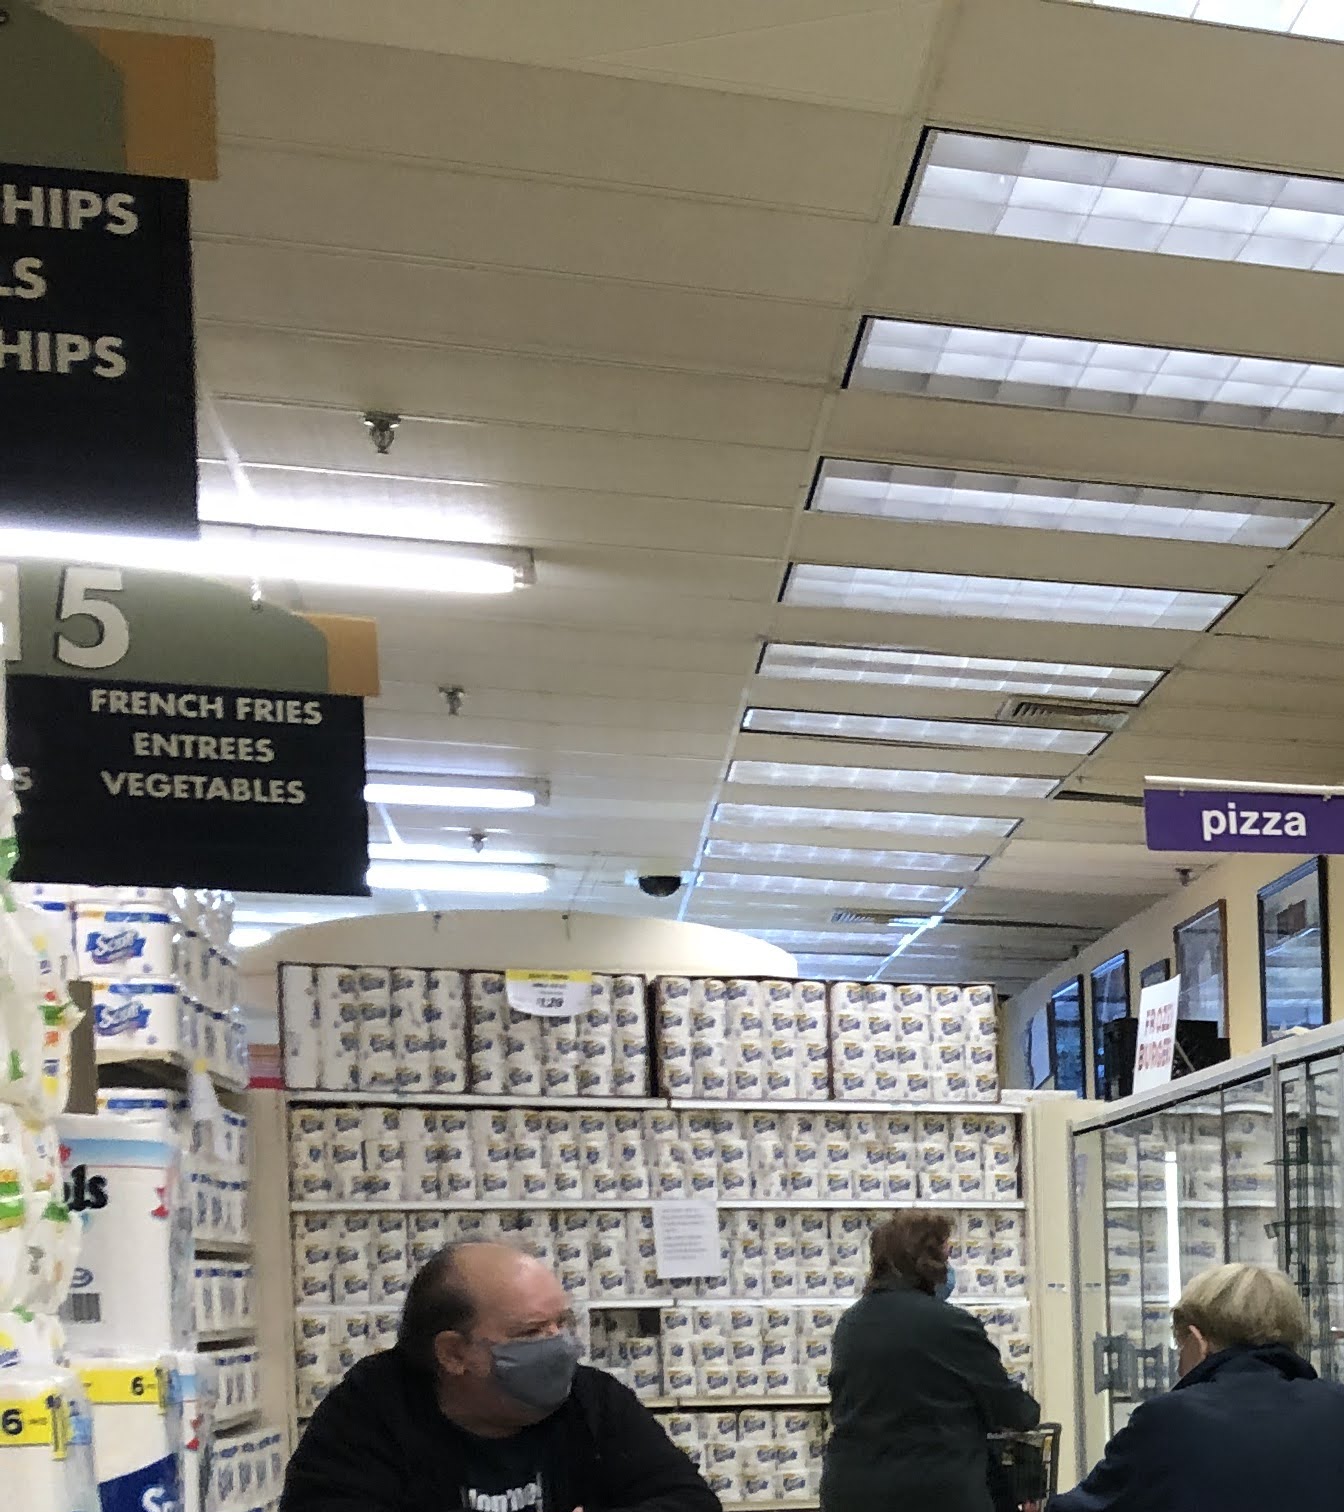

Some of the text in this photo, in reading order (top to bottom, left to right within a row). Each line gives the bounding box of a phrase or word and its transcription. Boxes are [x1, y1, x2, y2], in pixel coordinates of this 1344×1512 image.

[90, 688, 323, 725] FRENCH FRIES
[132, 731, 276, 763] ENTREES
[100, 770, 306, 804] VEGETABLES
[1202, 800, 1307, 841] pizza
[131, 1375, 145, 1397] 6
[1, 1408, 23, 1436] 6
